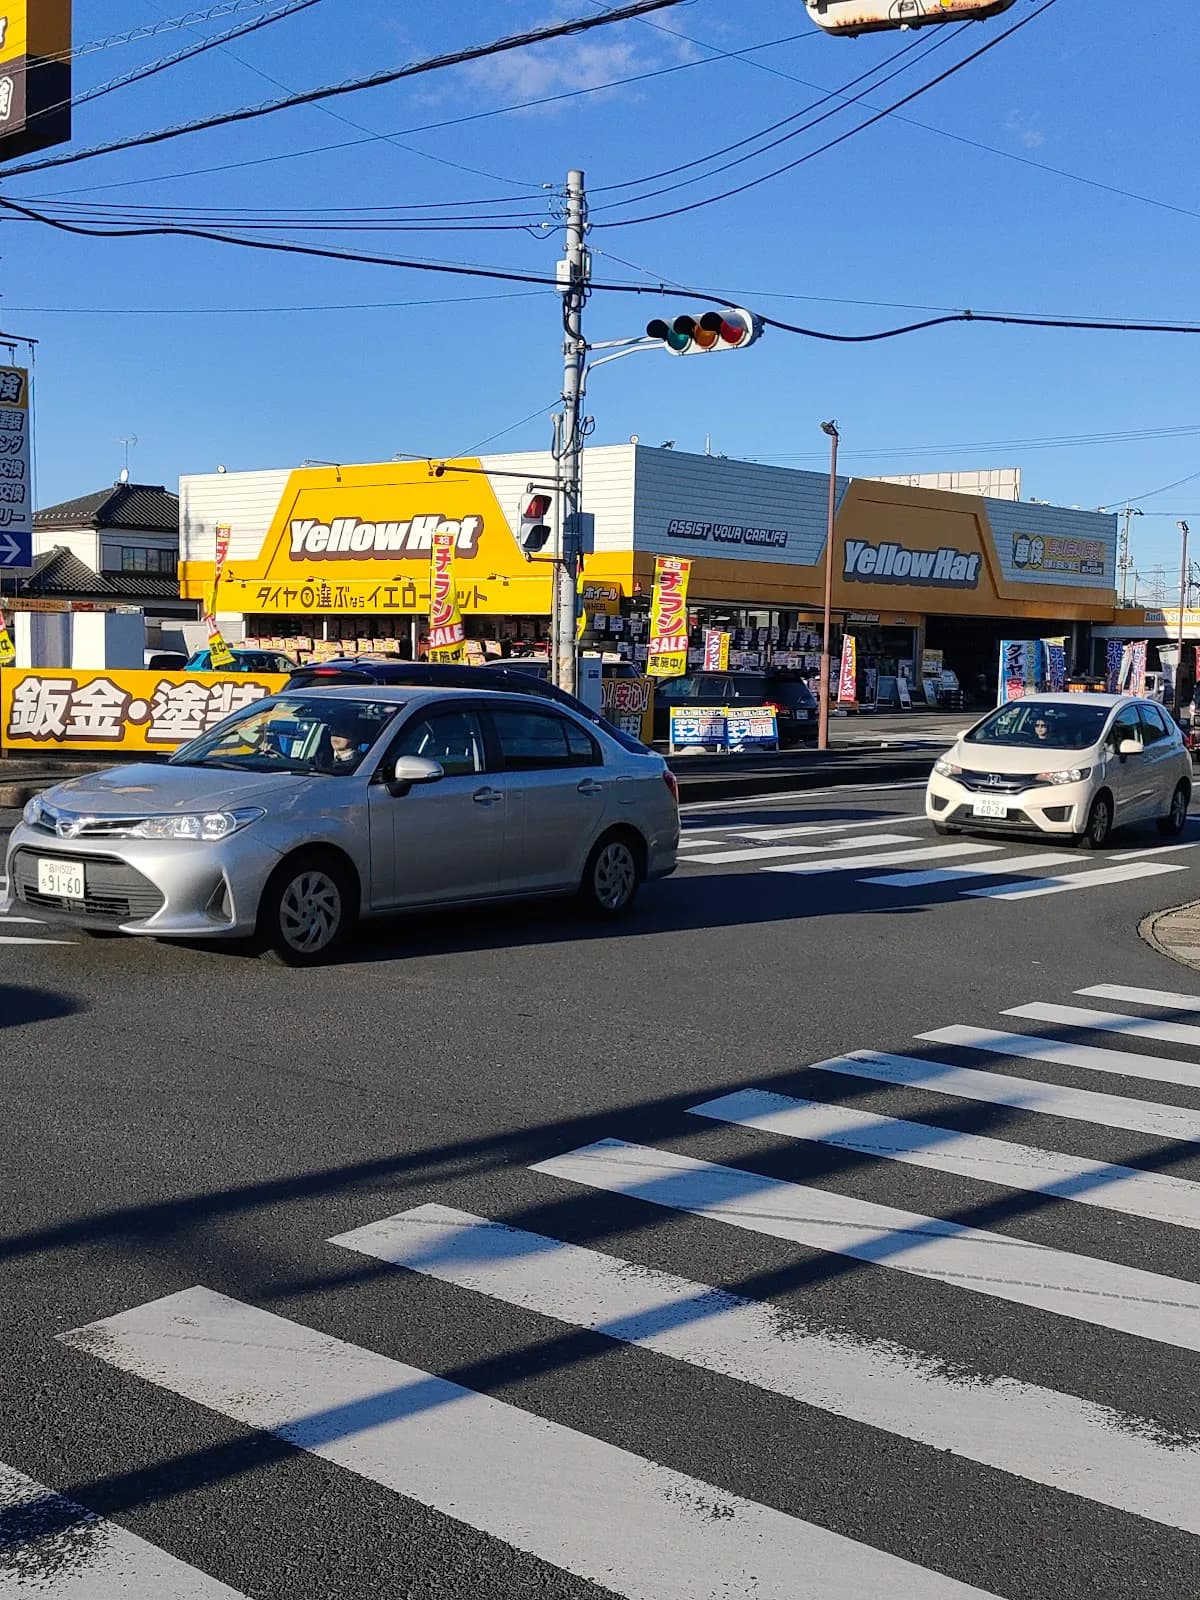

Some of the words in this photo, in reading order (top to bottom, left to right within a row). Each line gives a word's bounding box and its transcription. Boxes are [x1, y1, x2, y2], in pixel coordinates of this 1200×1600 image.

[669, 520, 711, 539] ASSIST
[713, 524, 742, 542] YOUR
[744, 528, 787, 546] CARLIFE
[844, 540, 981, 587] YellowHat
[432, 548, 453, 625] チラシ
[584, 586, 618, 600] ホイール
[658, 571, 684, 635] チラシ
[650, 636, 689, 654] SALE
